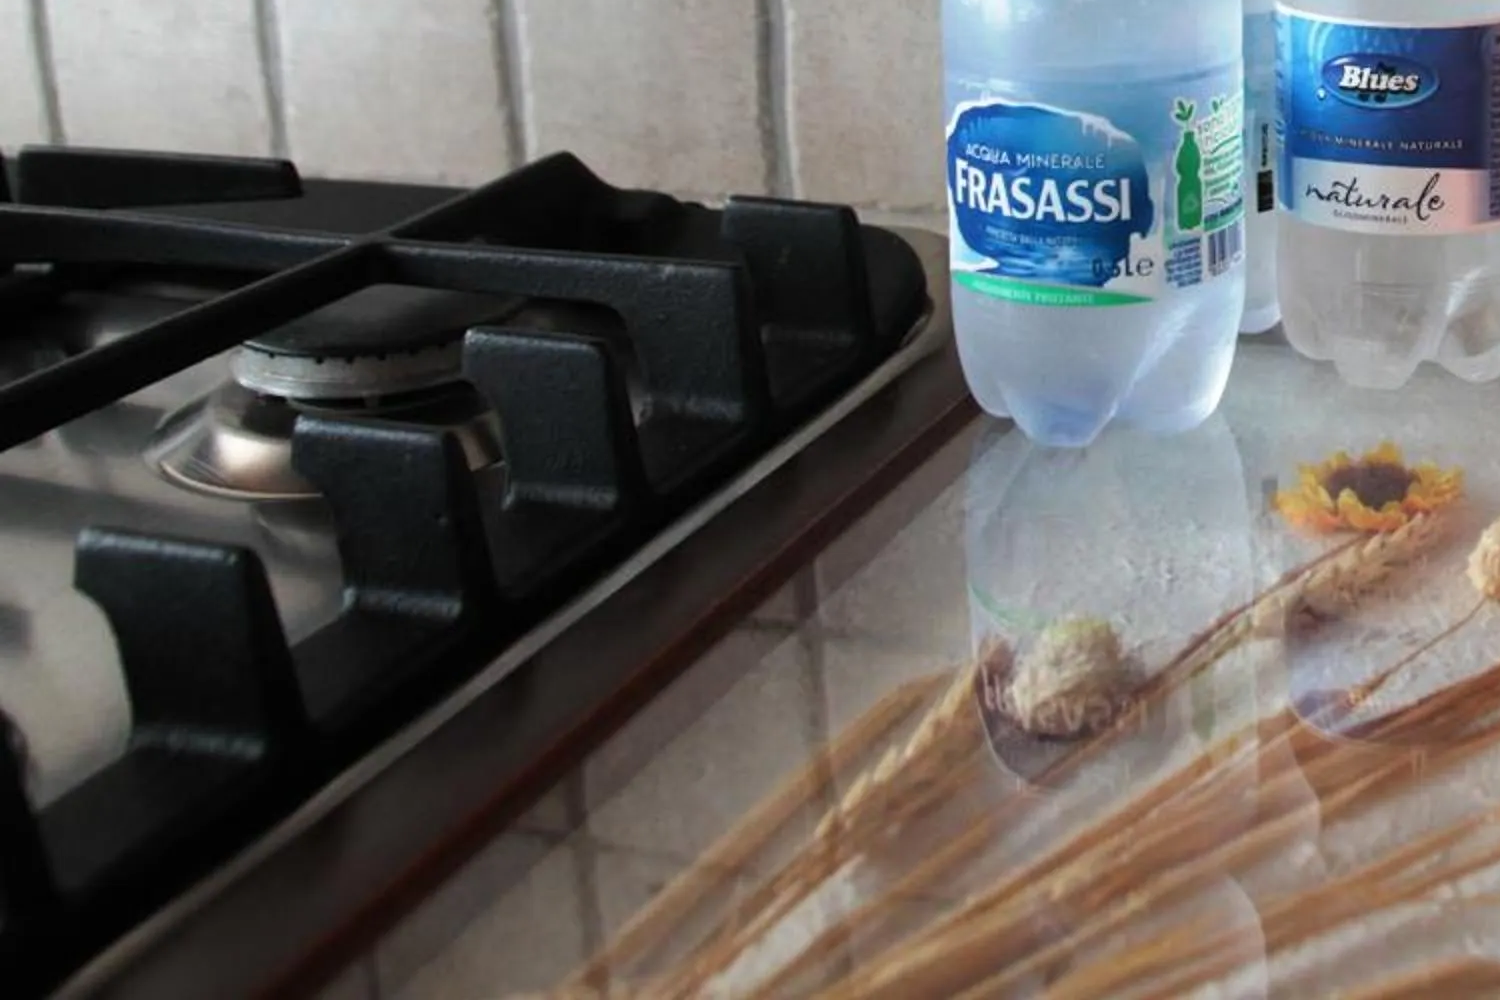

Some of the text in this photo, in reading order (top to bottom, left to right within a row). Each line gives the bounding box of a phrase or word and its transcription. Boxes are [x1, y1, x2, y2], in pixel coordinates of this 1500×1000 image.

[1339, 63, 1420, 92] Blues
[965, 143, 1105, 169] ACQUA MINERALE
[1400, 138, 1464, 150] NATURALE
[955, 157, 1132, 223] FRASASSI
[1305, 172, 1446, 221] naturale
